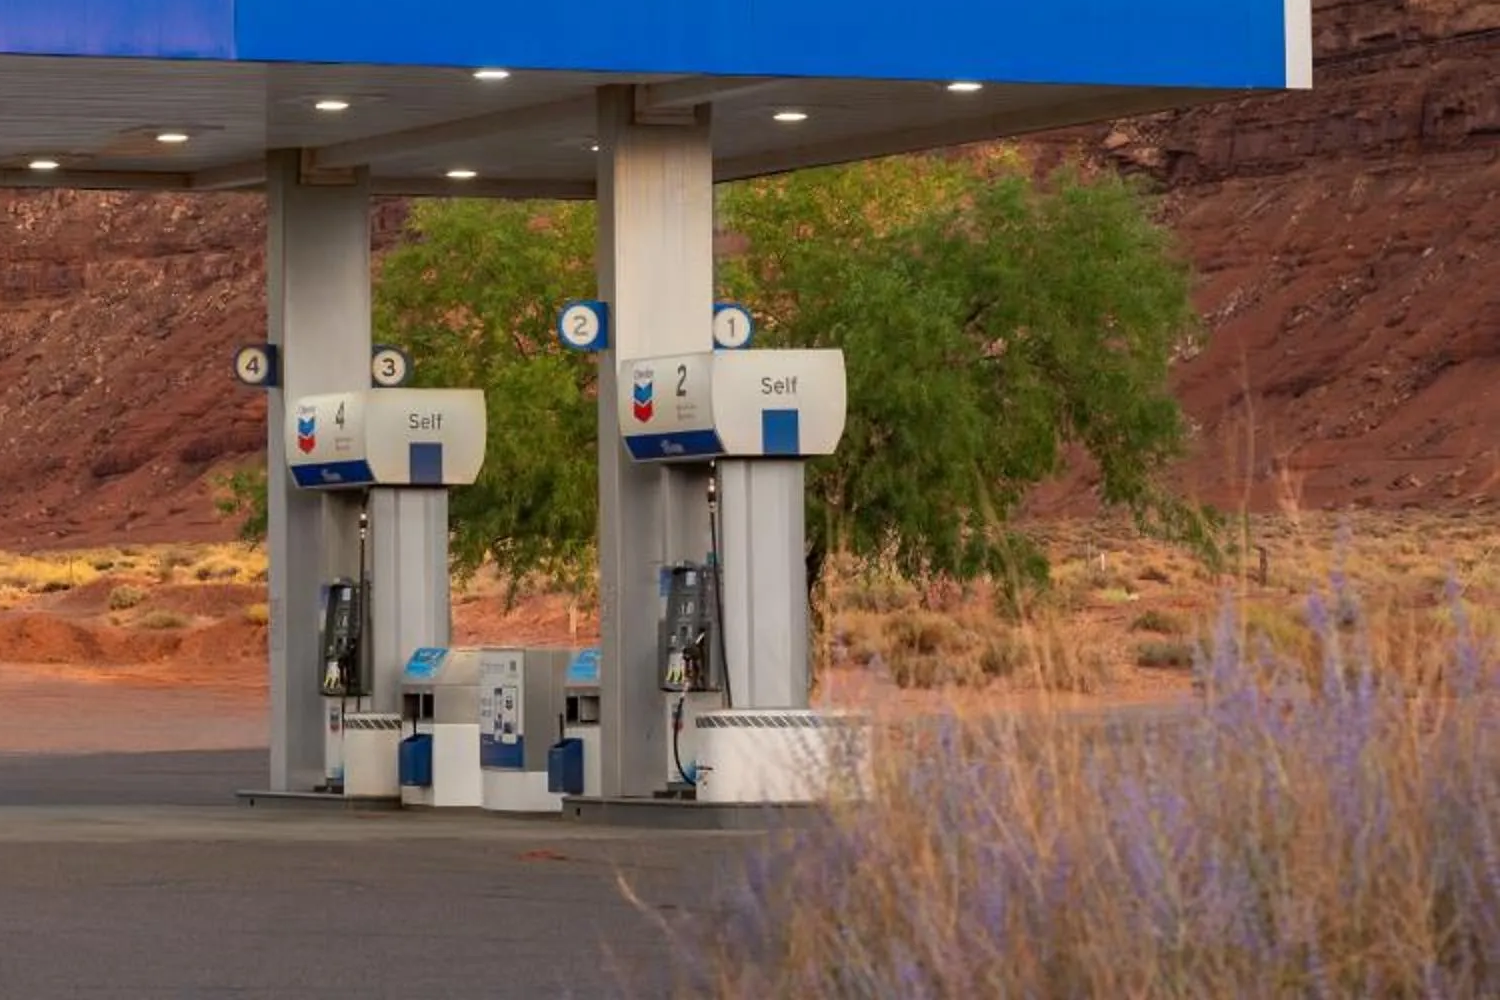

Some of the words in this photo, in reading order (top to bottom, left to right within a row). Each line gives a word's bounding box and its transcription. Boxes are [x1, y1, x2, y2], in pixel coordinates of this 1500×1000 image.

[572, 315, 589, 337] 2
[726, 317, 736, 338] 1
[245, 356, 260, 375] 4
[382, 358, 396, 377] 3
[676, 364, 687, 397] 2
[761, 376, 798, 395] Self
[335, 400, 345, 430] 4
[409, 413, 442, 430] Self
